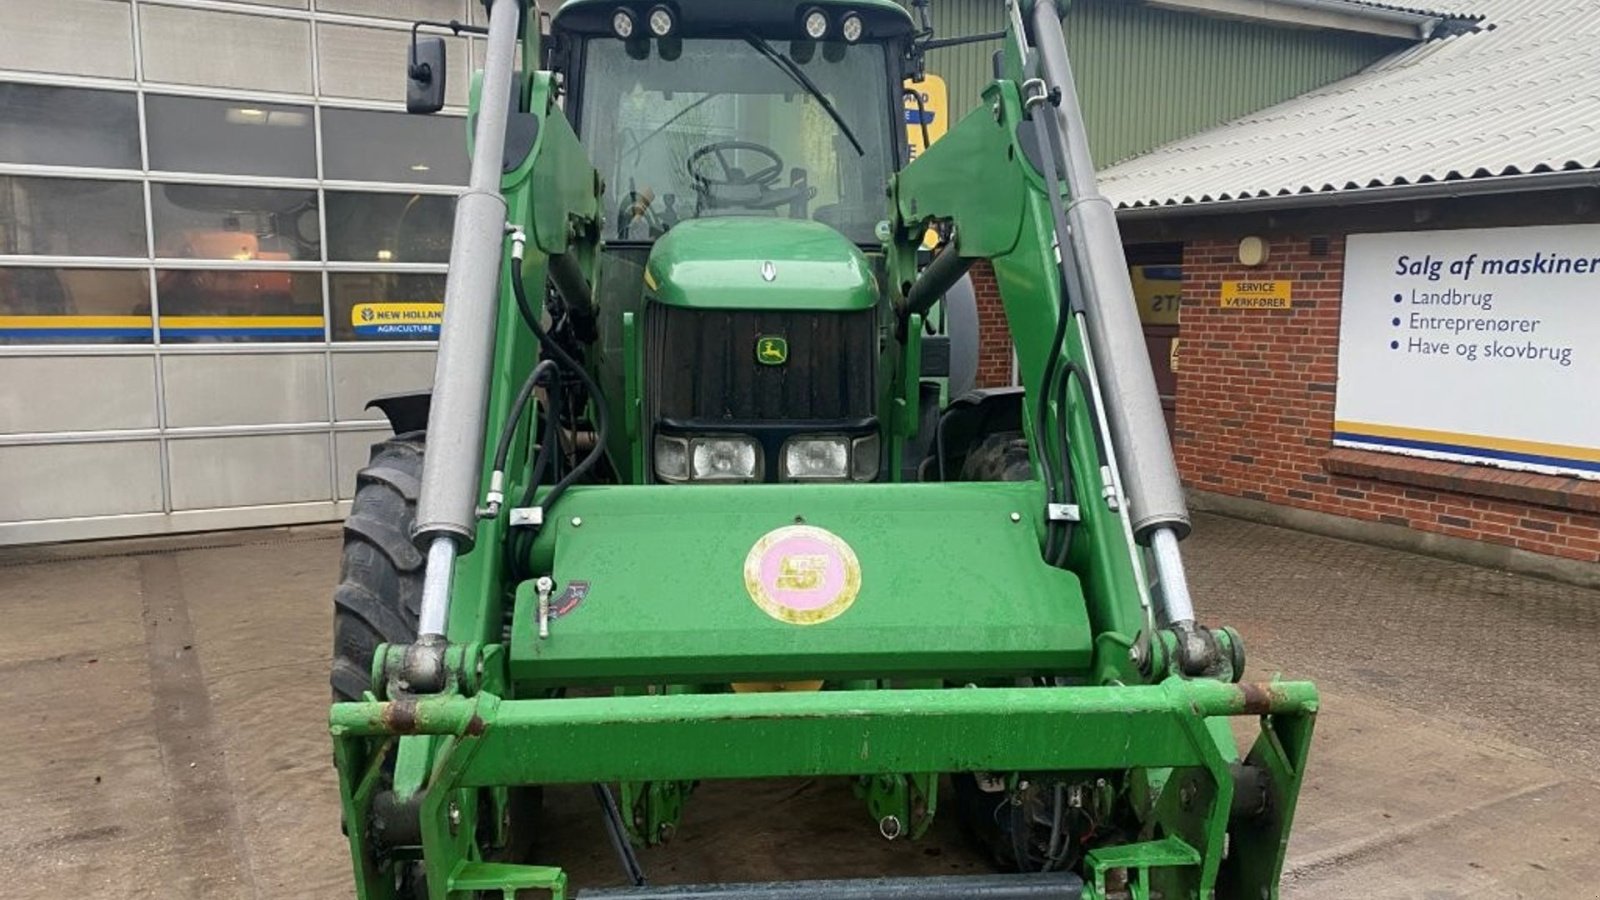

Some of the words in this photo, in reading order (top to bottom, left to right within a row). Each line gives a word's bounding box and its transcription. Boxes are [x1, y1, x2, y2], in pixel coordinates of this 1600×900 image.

[1396, 255, 1442, 281] Salg
[1450, 254, 1477, 280] af
[1481, 253, 1600, 275] maskiner
[1236, 282, 1275, 292] SERVICE
[1411, 288, 1493, 311] Landbrug
[377, 311, 400, 319] NEW
[403, 311, 442, 319] HOLLAN
[1409, 312, 1540, 335] Entreprenører
[378, 325, 433, 333] AGRICULTURE
[1407, 337, 1450, 355] Have
[1456, 343, 1477, 361] og
[1484, 341, 1572, 366] skovbrug
